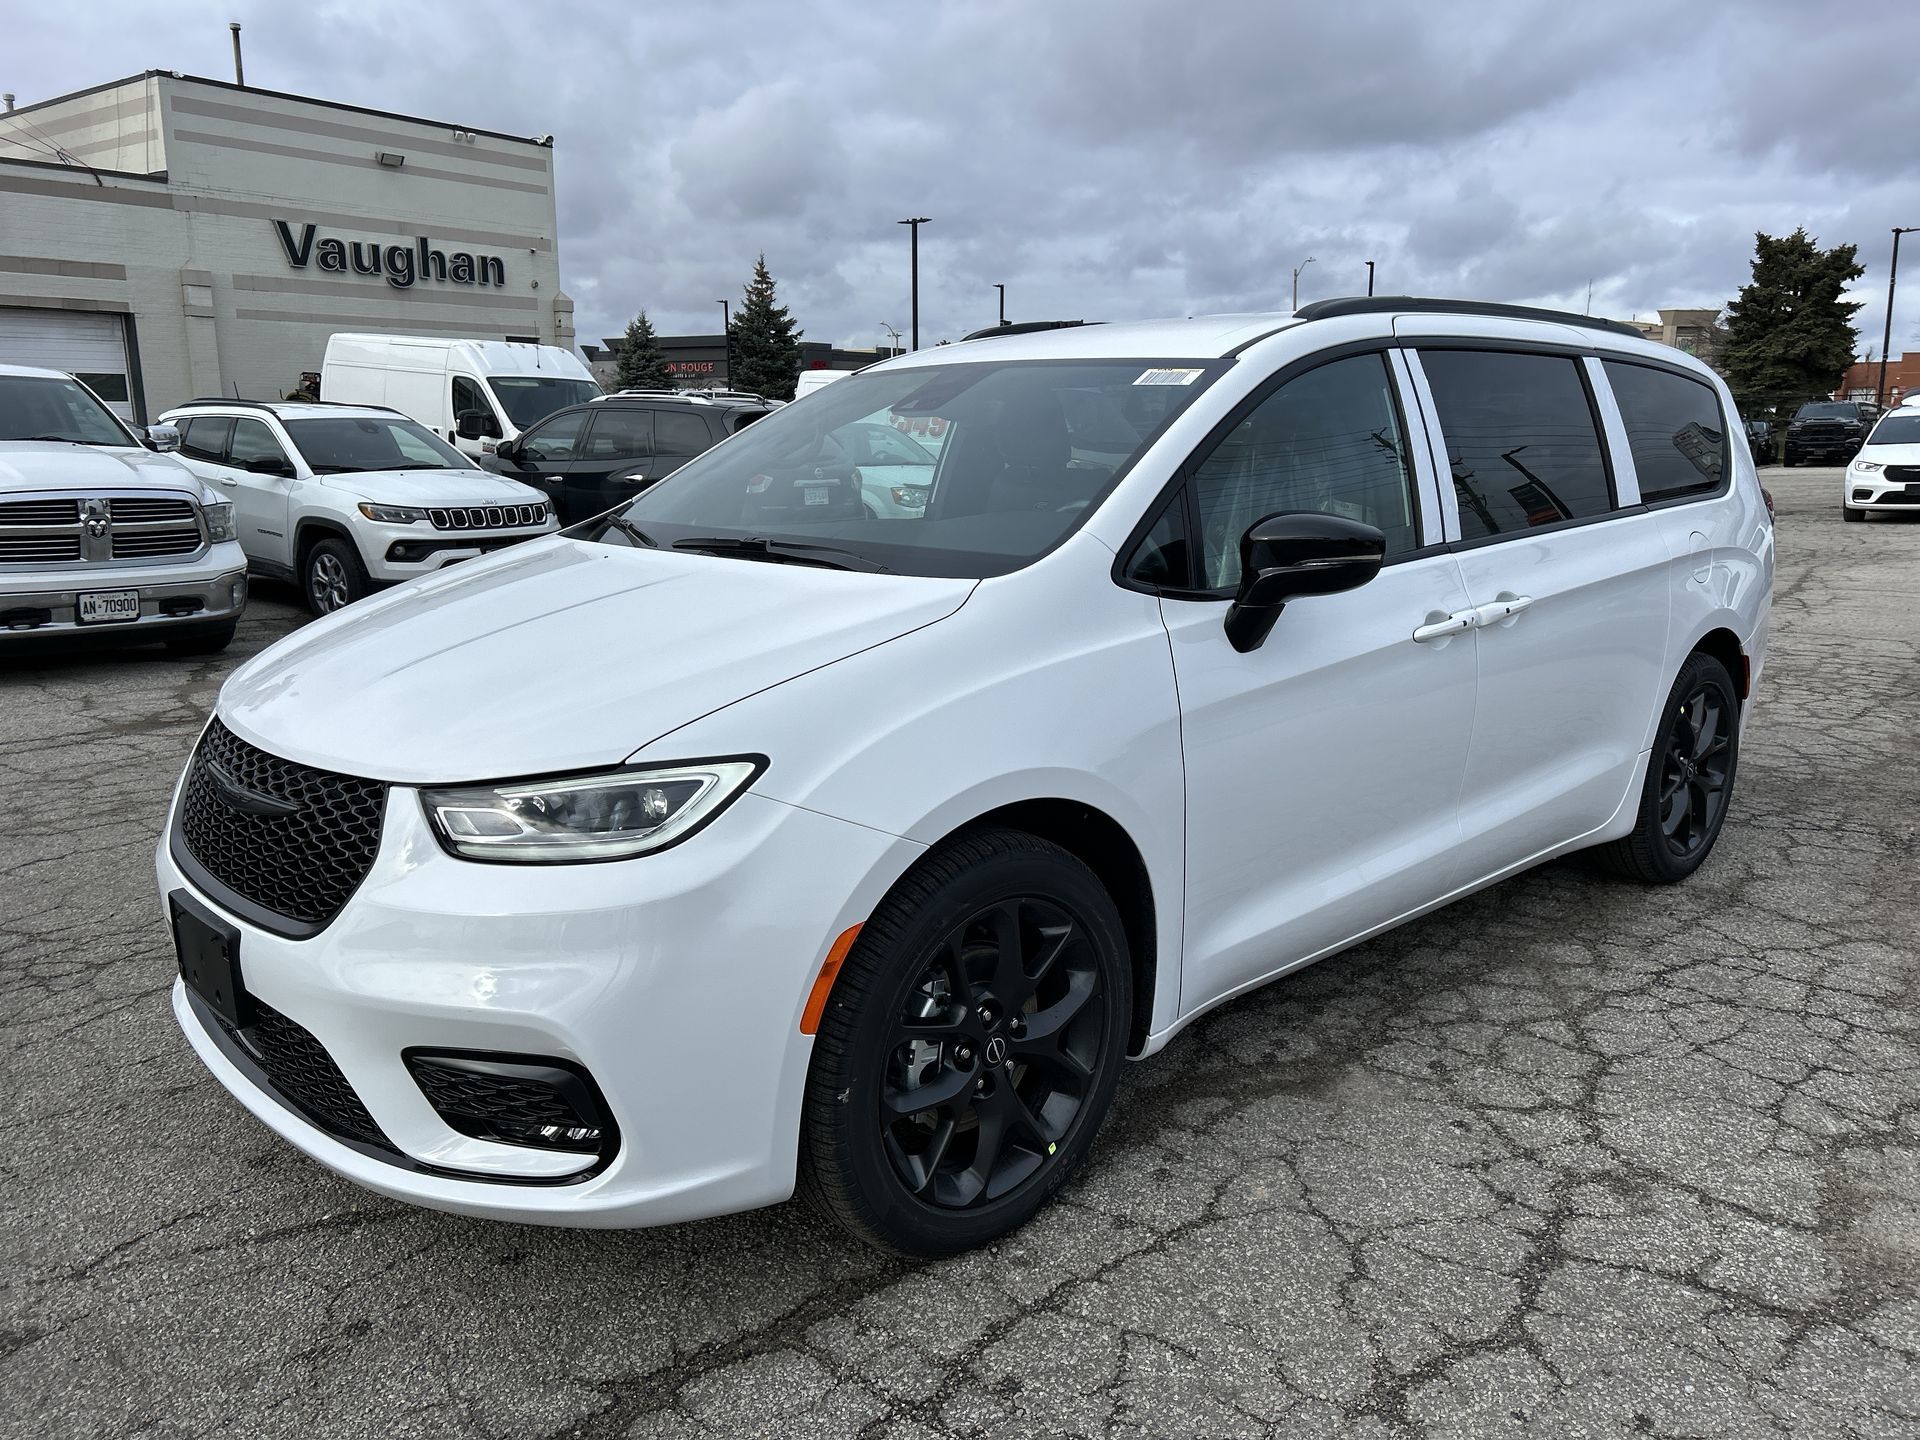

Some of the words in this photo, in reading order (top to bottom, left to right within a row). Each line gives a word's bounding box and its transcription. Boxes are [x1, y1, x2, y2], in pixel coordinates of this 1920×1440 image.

[270, 217, 506, 289] Vaughan
[681, 361, 714, 373] ROUGE
[83, 600, 97, 615] AN
[102, 598, 137, 613] 70900
